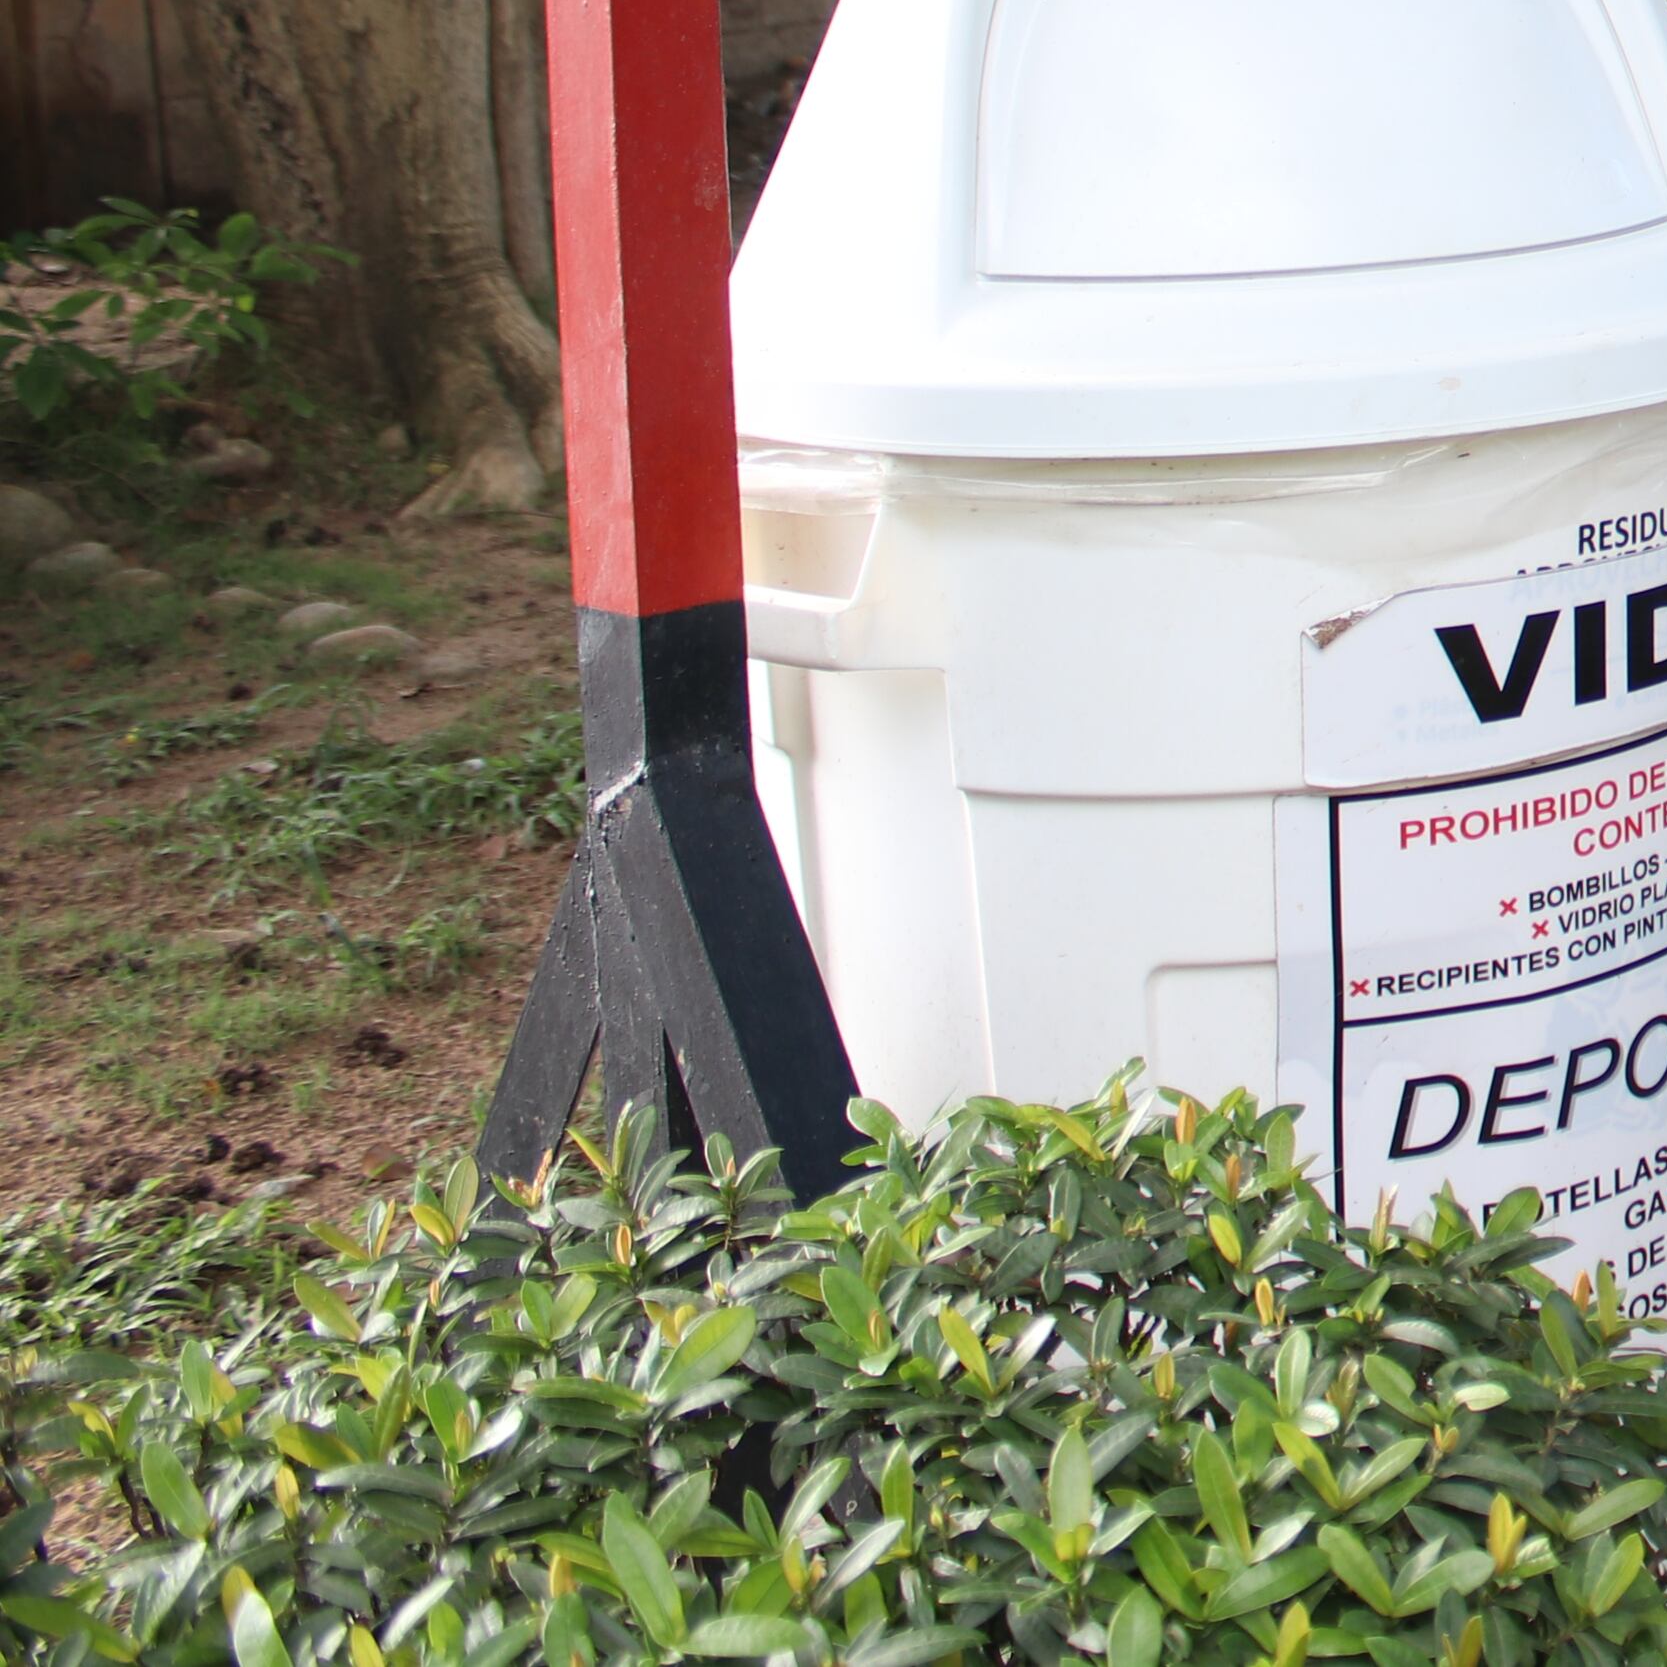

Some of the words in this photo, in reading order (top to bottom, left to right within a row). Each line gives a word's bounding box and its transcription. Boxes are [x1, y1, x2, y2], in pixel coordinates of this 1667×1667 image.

[1399, 781, 1619, 849] PROHIBIDO
[1529, 855, 1659, 913] BOMBILLOS
[1558, 895, 1634, 933] VIDRIO
[1376, 947, 1560, 996] RECIPIENTES
[1568, 930, 1616, 960] CON
